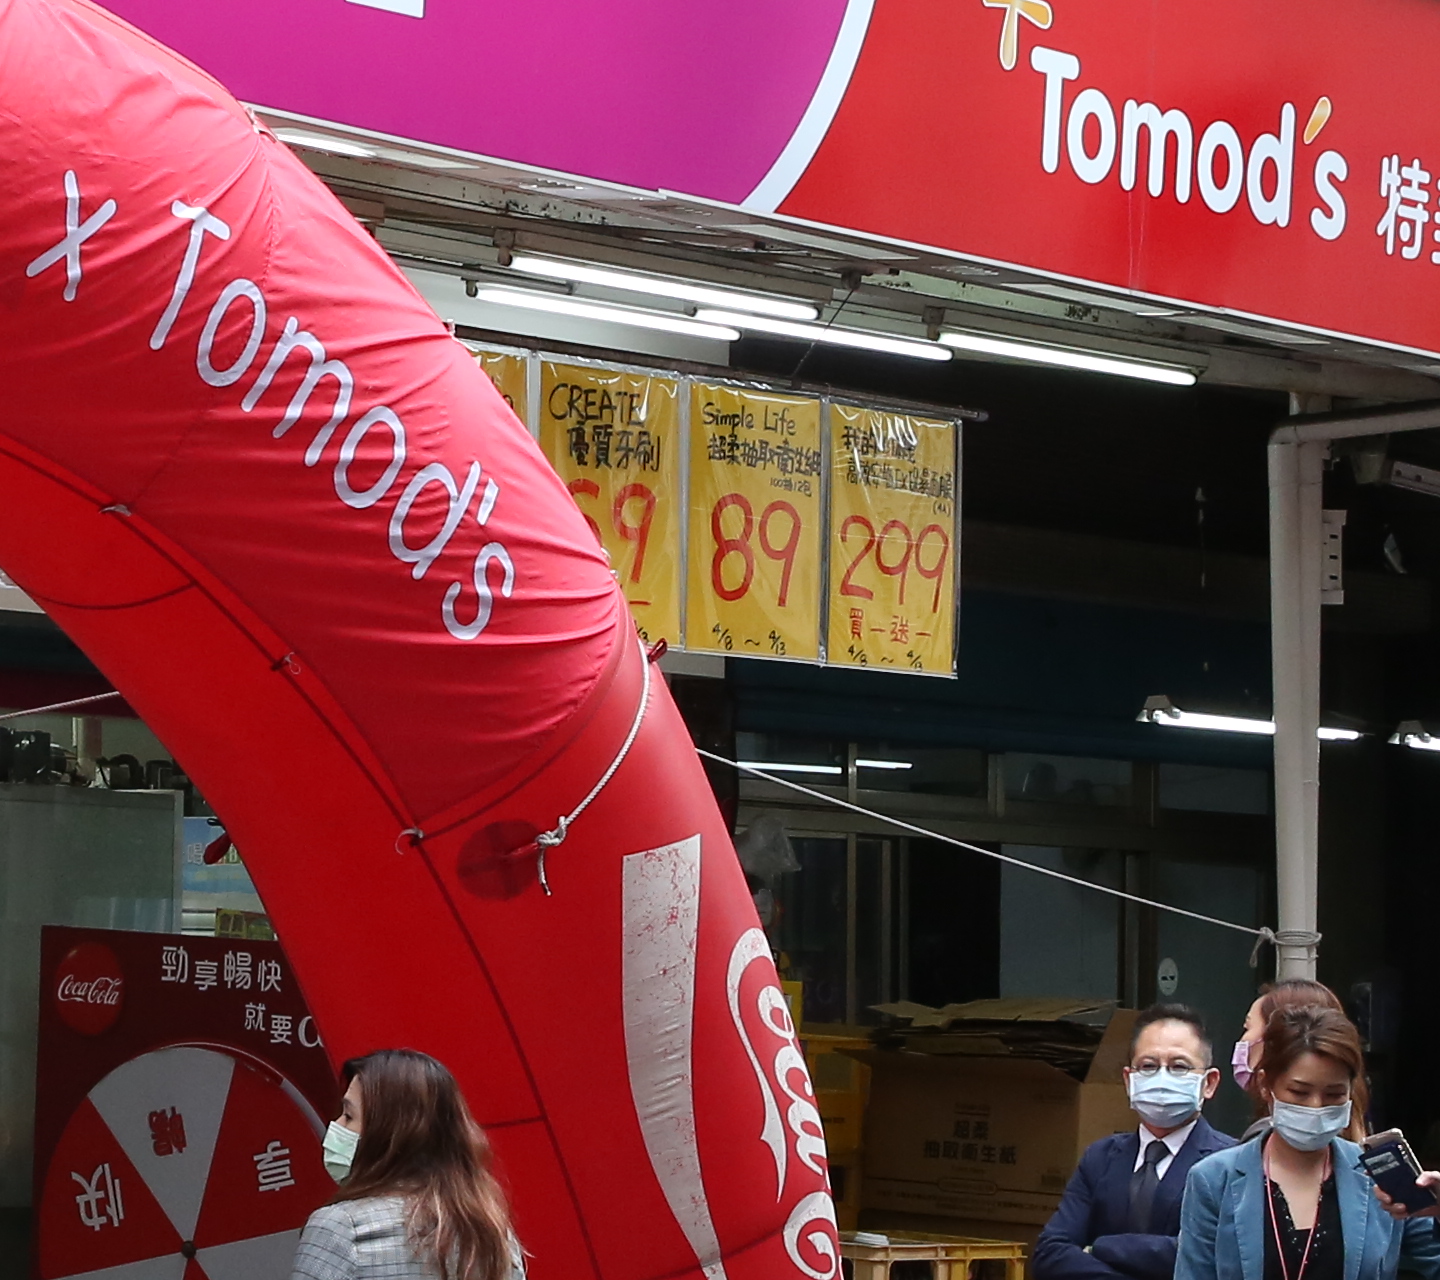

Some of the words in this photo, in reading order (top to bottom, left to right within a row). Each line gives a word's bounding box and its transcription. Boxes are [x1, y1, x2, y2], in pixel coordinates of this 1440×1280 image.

[1031, 43, 1348, 240] Tomod's
[148, 197, 516, 641] Tomod's
[549, 382, 645, 426] CREATE
[702, 401, 755, 434] Simple
[763, 406, 798, 437] Life
[567, 423, 662, 472] 優質牙刷
[710, 492, 802, 608] 89
[839, 515, 951, 614] 299
[712, 622, 734, 651] 4/8
[848, 607, 932, 646] 買一送一
[847, 646, 868, 668] 4/8
[57, 974, 123, 1007] Coca-Cola
[161, 945, 283, 993] 勁享暢快
[244, 1001, 293, 1045] 就要
[252, 1140, 296, 1192] 享
[70, 1162, 125, 1232] 快
